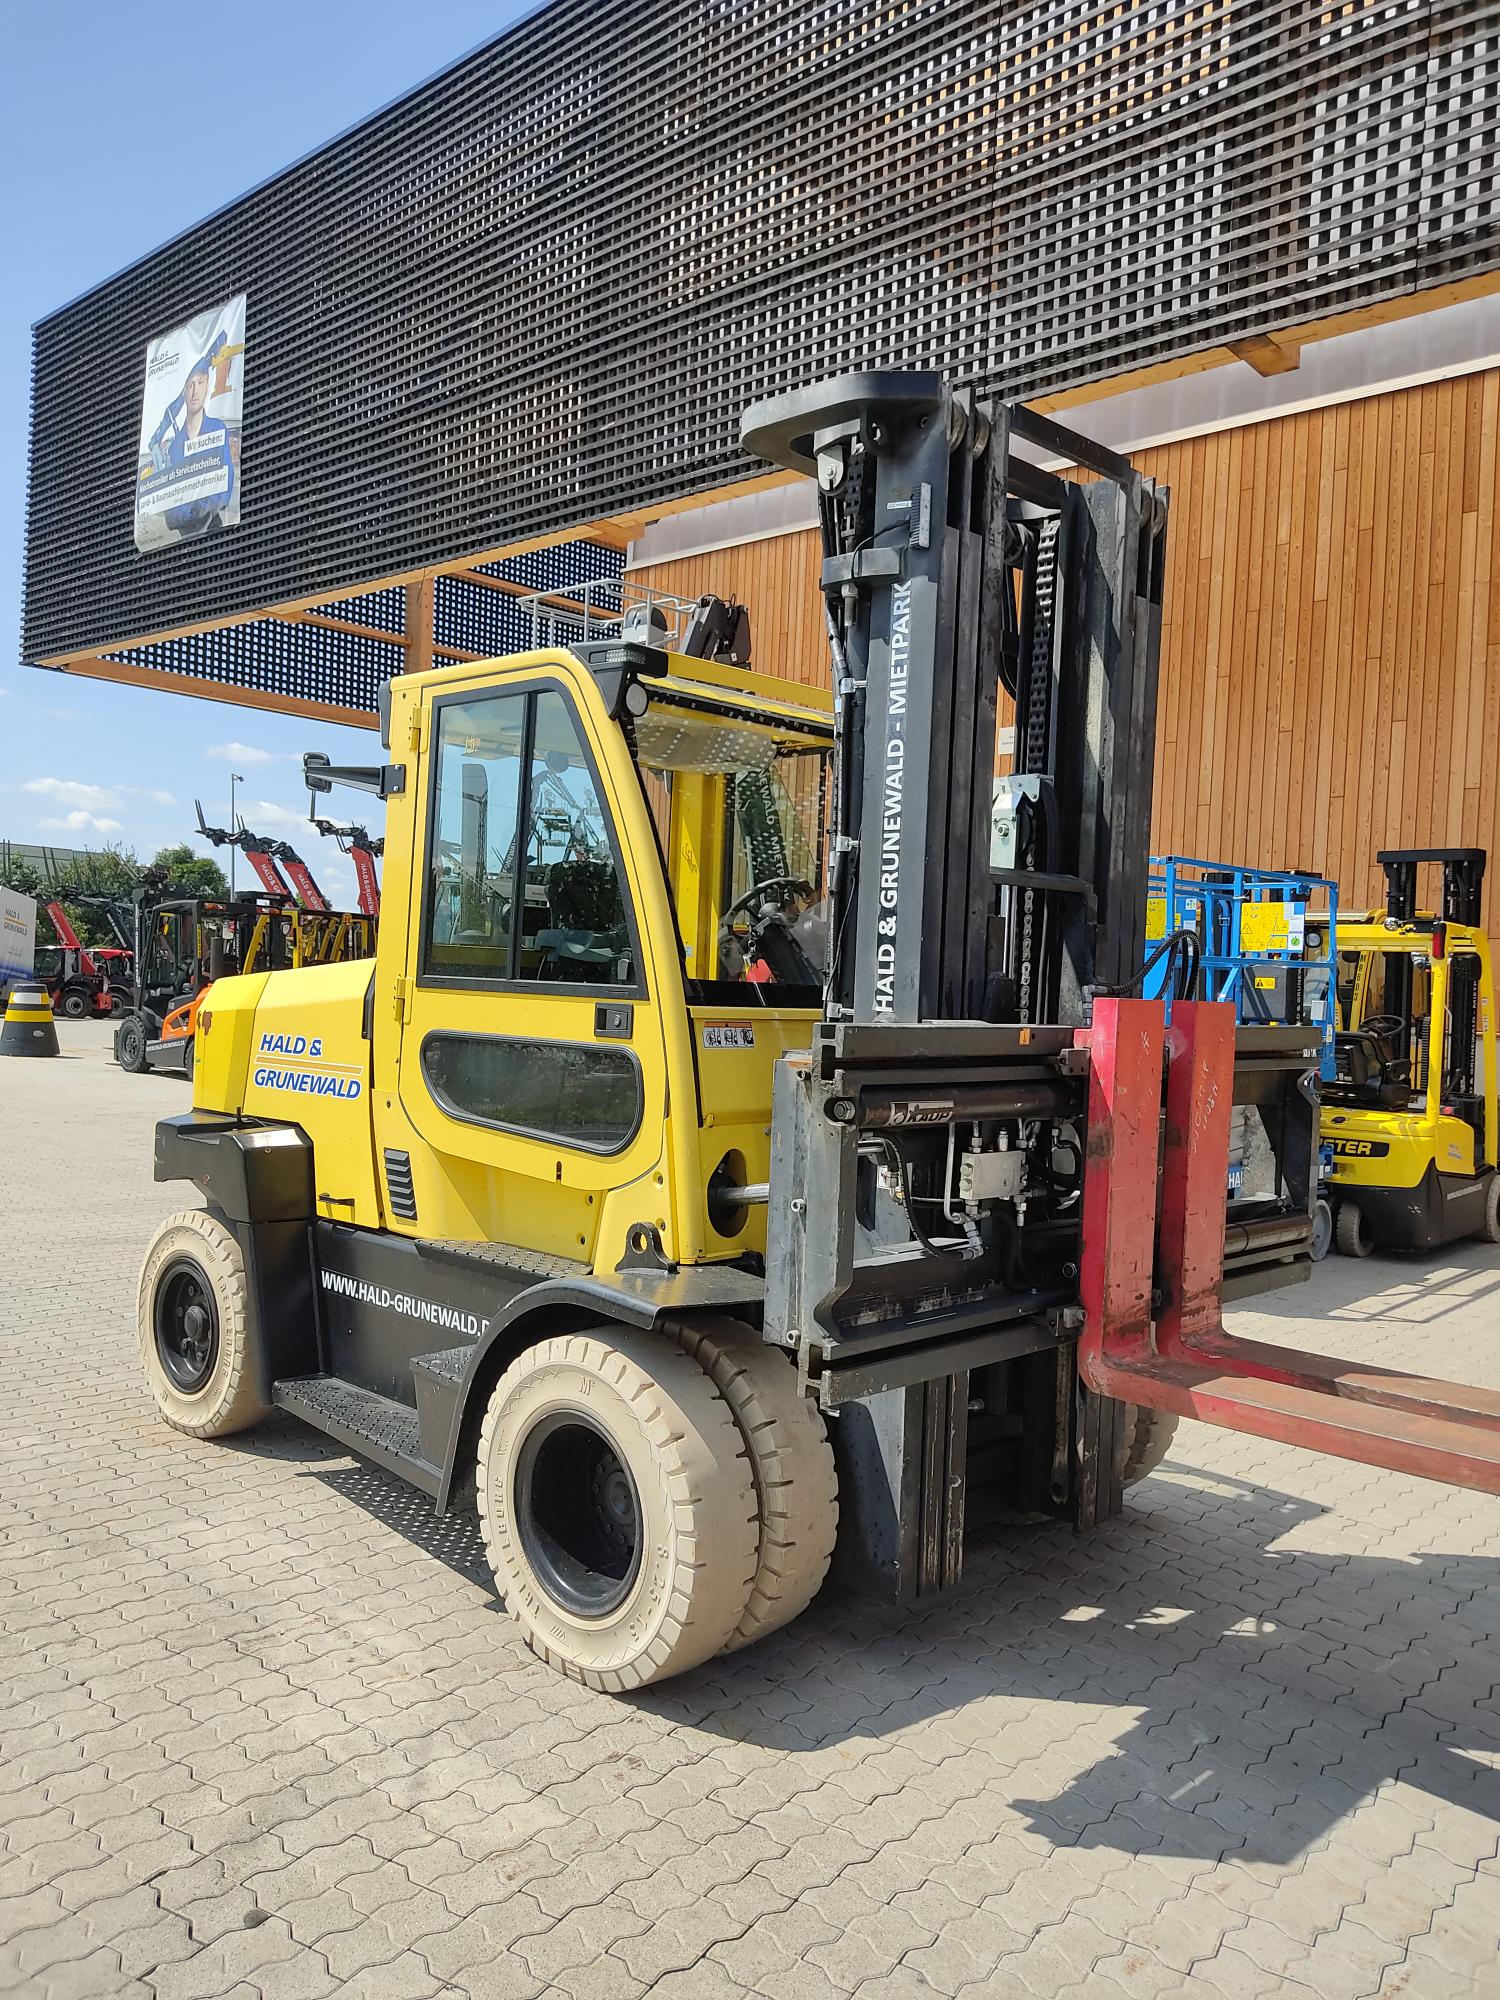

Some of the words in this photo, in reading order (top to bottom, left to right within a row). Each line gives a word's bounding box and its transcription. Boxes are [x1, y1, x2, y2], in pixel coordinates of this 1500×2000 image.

[187, 441, 197, 453] Wir
[198, 434, 223, 448] suchen:
[176, 456, 221, 478] Servicetechniker,
[889, 580, 913, 713] MIETPARK
[760, 769, 775, 825] NEWALD
[878, 739, 905, 909] GRUNEWALD
[261, 864, 274, 882] HALD
[298, 873, 309, 890] HALD
[361, 863, 369, 880] HALD
[365, 884, 375, 915] GRUNEWA
[878, 916, 897, 936] &
[876, 942, 895, 1013] HALD
[260, 1034, 307, 1055] HALD
[309, 1039, 322, 1056] &
[254, 1068, 361, 1099] GRUNEWALD
[1320, 1138, 1372, 1156] STER
[321, 1270, 490, 1337] WWW.HALD-GRUNEWALD.D
